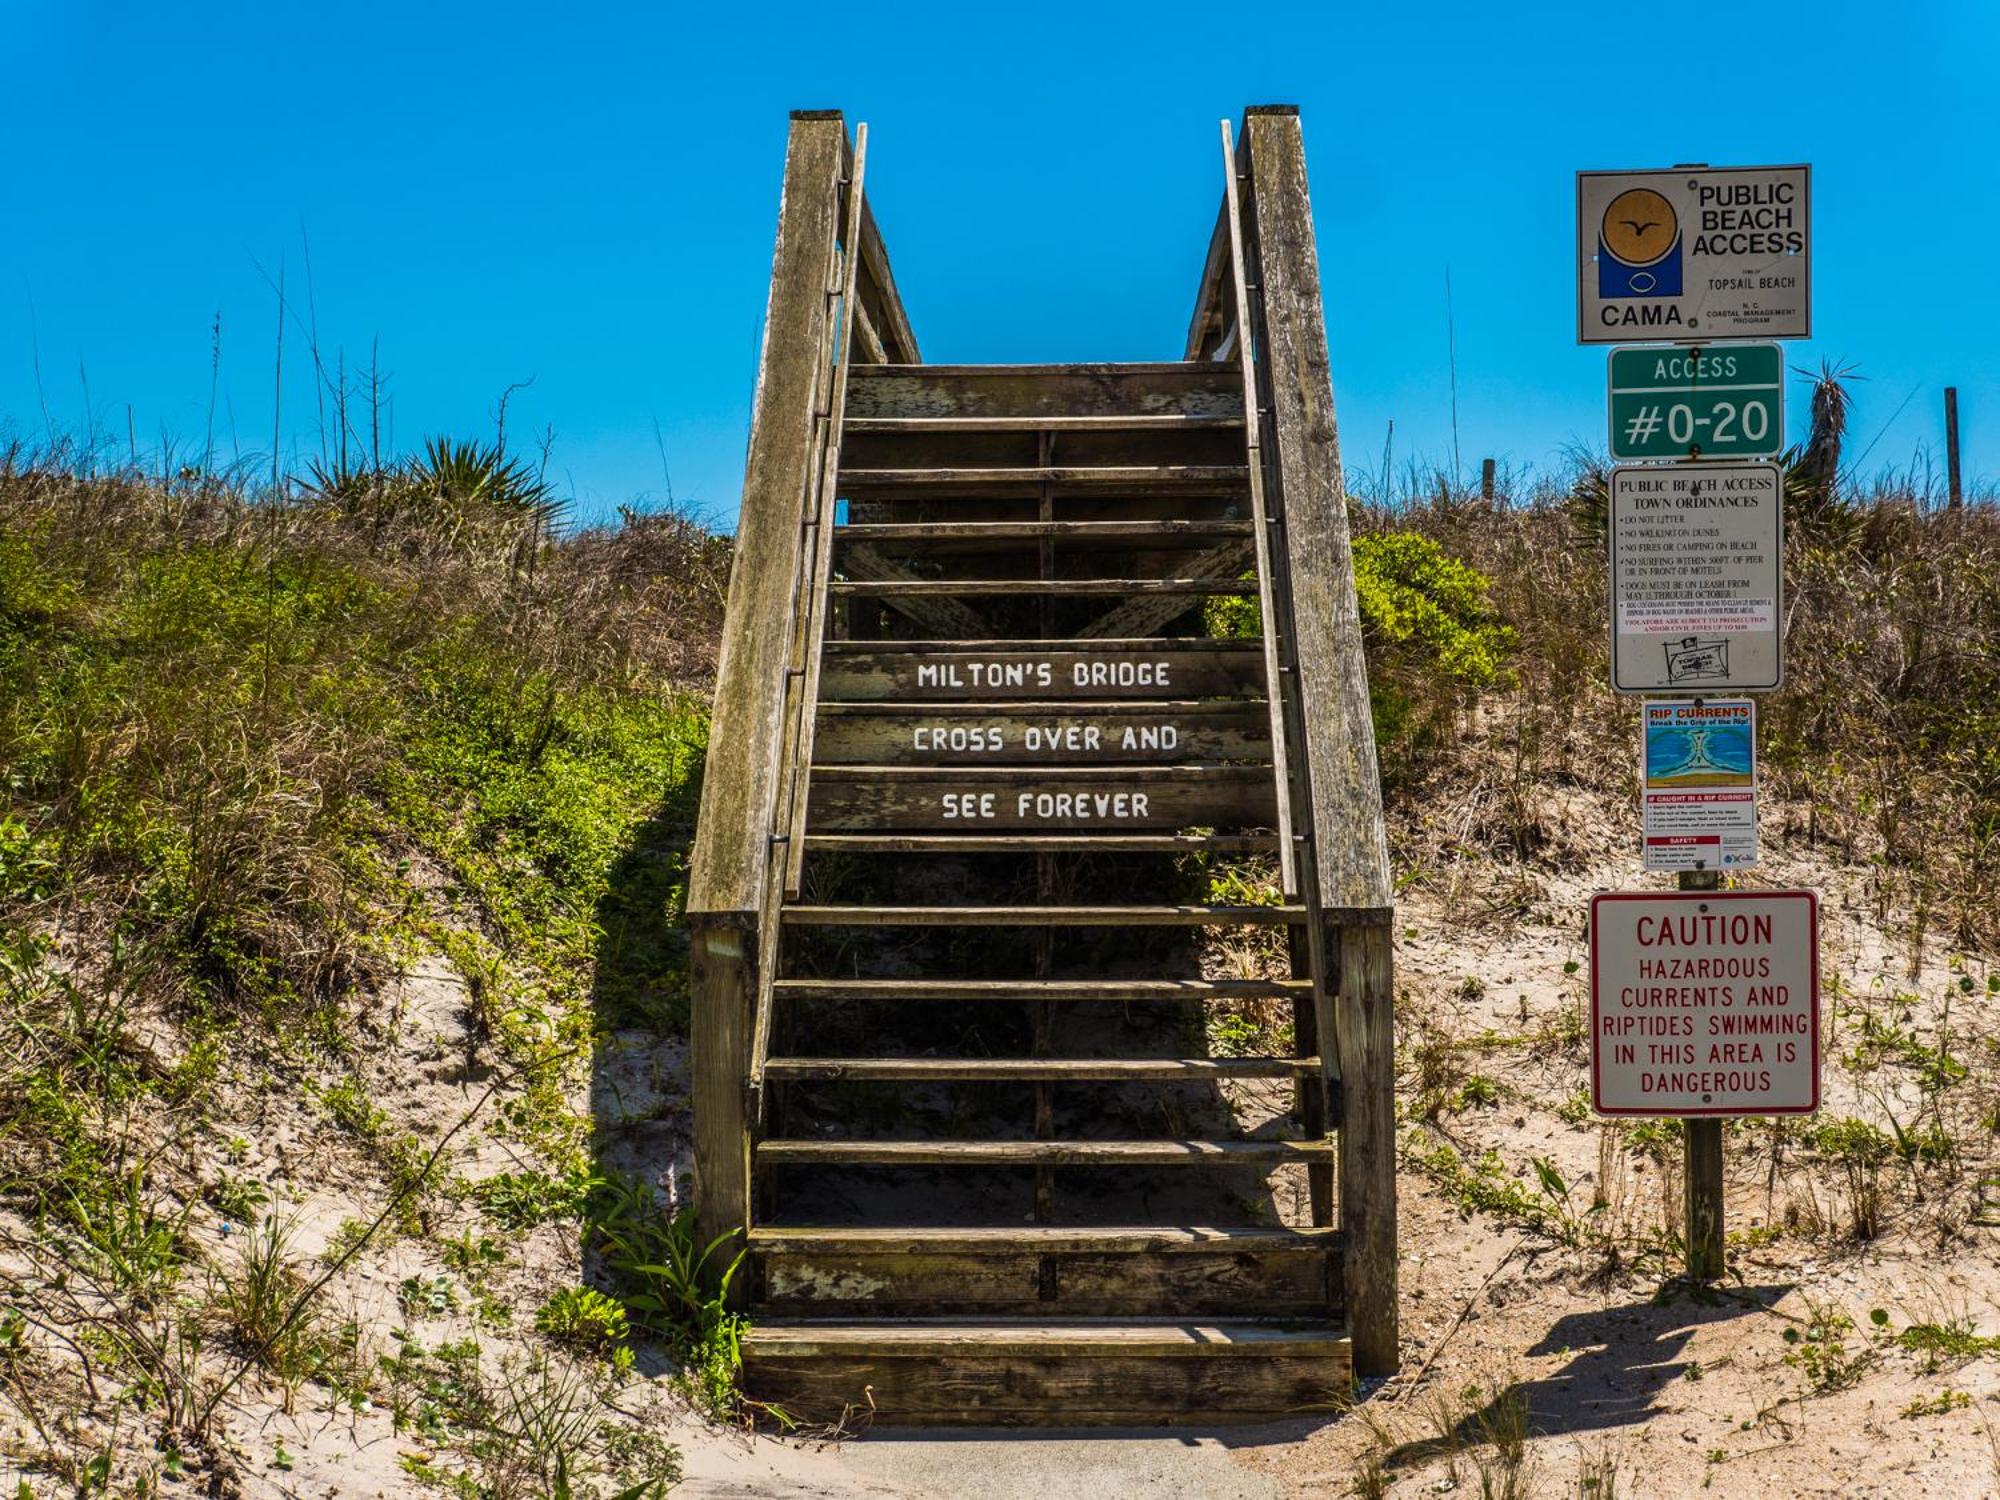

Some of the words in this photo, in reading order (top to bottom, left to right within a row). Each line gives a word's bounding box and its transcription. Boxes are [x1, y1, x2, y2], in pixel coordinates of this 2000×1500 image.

[1700, 183, 1794, 207] PUBLIC
[1703, 208, 1792, 231] BEACH
[1692, 232, 1803, 256] ACCESS
[1709, 278, 1754, 290] TOPSAIL
[1760, 276, 1795, 288] BEACH
[1601, 304, 1682, 327] CAMA
[1743, 309, 1796, 317] MANAGEMENT
[1654, 357, 1737, 380] ACCESS
[1625, 401, 1768, 445] #0-20
[1620, 480, 1669, 493] PUBLIC
[1673, 479, 1717, 492] BEACH
[1722, 478, 1773, 491] ACCESS
[1634, 498, 1671, 510] TOWN
[1676, 496, 1759, 509] ORDINANCES
[1625, 516, 1636, 524] DO
[1639, 515, 1655, 524] NOT
[1657, 515, 1684, 524] LITTER
[1625, 530, 1636, 538] NO
[1639, 529, 1676, 538] WALKING
[1678, 529, 1690, 537] ON
[1625, 544, 1636, 552] NO
[1639, 543, 1661, 552] FIRES
[1663, 543, 1674, 551] OR
[1677, 542, 1714, 551] CAMPING
[1716, 542, 1728, 550] ON
[1730, 541, 1757, 550] BEACH
[1625, 558, 1637, 566] NO
[1638, 557, 1674, 566] SURFING
[1733, 555, 1743, 564] OF
[1625, 567, 1635, 576] OR
[1639, 567, 1647, 576] IN
[1649, 567, 1676, 576] FRONT
[1678, 567, 1688, 575] OF
[1649, 581, 1670, 590] MUST
[1685, 581, 1697, 589] ON
[1700, 580, 1724, 589] LEASH
[1728, 579, 1750, 588] FROM
[1625, 592, 1642, 600] MAY
[917, 663, 1051, 687] MILTON'S
[1073, 662, 1171, 686] BRIDGE
[1650, 708, 1672, 718] RIP
[1677, 707, 1748, 718] CURRENTS
[914, 727, 1003, 751] CROSS
[1024, 726, 1100, 750] OVER
[1122, 725, 1177, 750] AND
[942, 793, 996, 818] SEE
[1018, 793, 1149, 818] FOREVER
[1637, 915, 1772, 946] CAUTION
[1639, 958, 1770, 979] HAZARDOUS
[1621, 987, 1733, 1008] CURRENTS
[1747, 986, 1789, 1006] AND
[1603, 1016, 1694, 1036] RIPTIDES
[1708, 1014, 1807, 1035] SWIMMING
[1615, 1045, 1635, 1064] IN
[1649, 1044, 1695, 1064] THIS
[1709, 1043, 1763, 1064] AREA
[1777, 1042, 1796, 1063] IS
[1642, 1071, 1771, 1092] DANGEROUS
